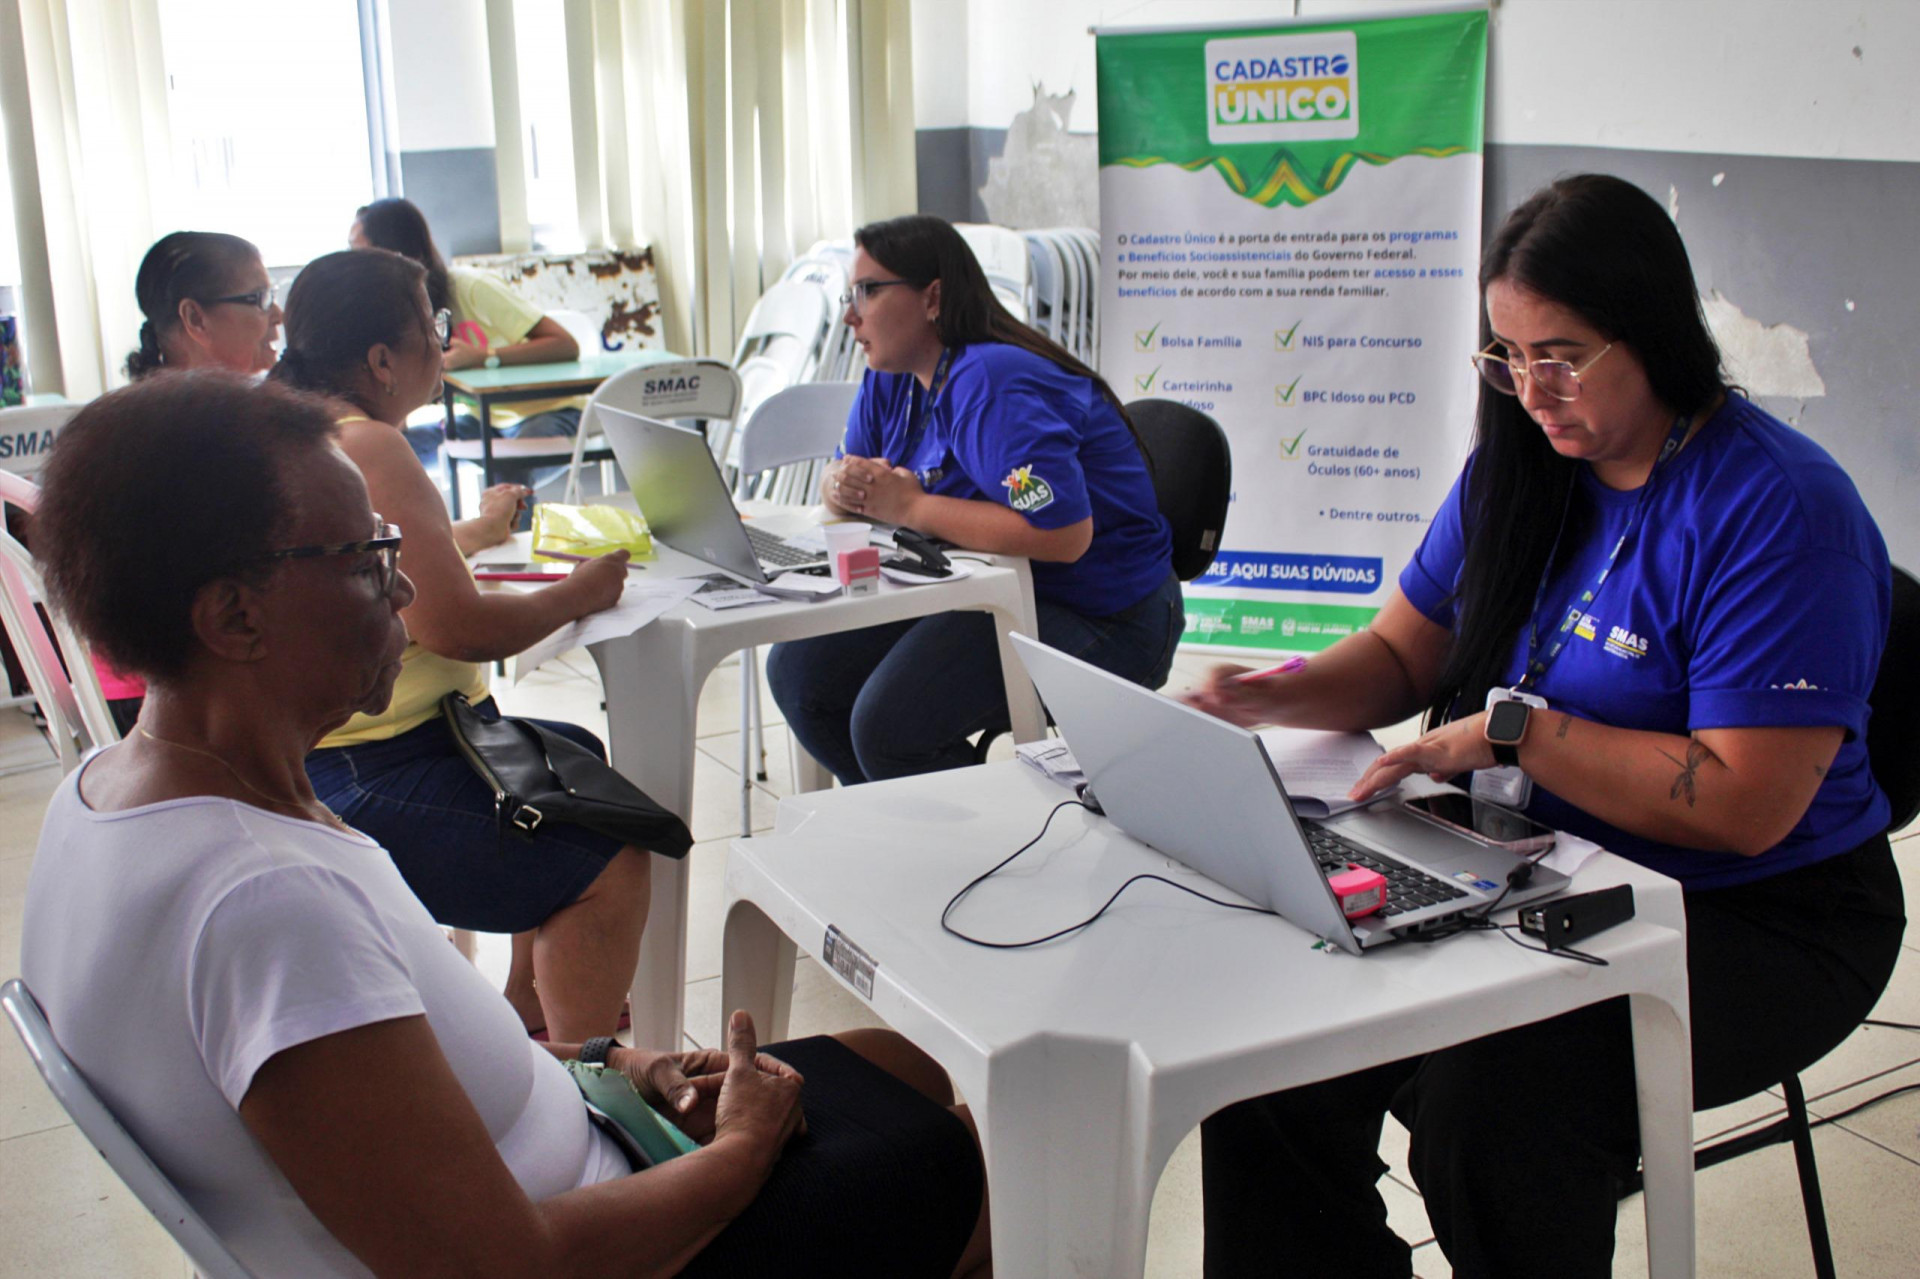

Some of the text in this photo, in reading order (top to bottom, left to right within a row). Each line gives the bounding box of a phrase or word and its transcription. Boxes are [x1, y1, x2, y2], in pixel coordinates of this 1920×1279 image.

[1215, 54, 1349, 81] CADASTRO
[1217, 85, 1347, 122] ÚNICO
[1117, 234, 1128, 245] O
[1130, 233, 1181, 245] Cadastro
[1184, 230, 1216, 244] Único
[1228, 234, 1236, 243] a
[1238, 233, 1270, 246] porta
[1273, 231, 1287, 243] de
[1290, 231, 1338, 242] entrada
[1341, 232, 1369, 246] para
[1372, 231, 1386, 242] os
[1389, 229, 1458, 243] programas
[1118, 254, 1125, 262] e
[1190, 250, 1292, 263] Socioassistenciais
[1294, 249, 1309, 260] do
[1312, 249, 1363, 260] Governo
[1367, 247, 1417, 260] Federal.
[1118, 269, 1138, 280] Por
[1141, 269, 1169, 280] meio
[1203, 267, 1229, 279] você
[1231, 270, 1238, 279] e
[1241, 270, 1261, 279] sua
[1308, 267, 1350, 281] podem
[1353, 267, 1370, 278] ter
[1374, 268, 1416, 278] acesso
[1419, 268, 1426, 278] a
[1430, 267, 1464, 277] esses
[1180, 286, 1194, 297] de
[1197, 286, 1236, 297] acordo
[1239, 288, 1263, 297] com
[1266, 288, 1273, 297] a
[1276, 288, 1296, 297] sua
[1300, 285, 1335, 297] renda
[1337, 284, 1389, 297] familiar.
[1161, 336, 1194, 348] Bolsa
[1303, 335, 1422, 350] NIS para Concurso
[644, 375, 700, 394] SMAC
[1162, 380, 1233, 392] Carteirinha
[1303, 390, 1416, 404] BPC Idoso ou PCD
[0, 429, 54, 458] SMA
[1307, 445, 1400, 458] Gratuidade de
[1307, 461, 1421, 480] Óculos (60+ anos)
[1329, 507, 1373, 520] Dentre
[1230, 562, 1268, 580] AQUI
[1271, 565, 1309, 580] SUAS
[1312, 563, 1376, 584] DÚVIDAS
[1609, 625, 1649, 652] SMAS
